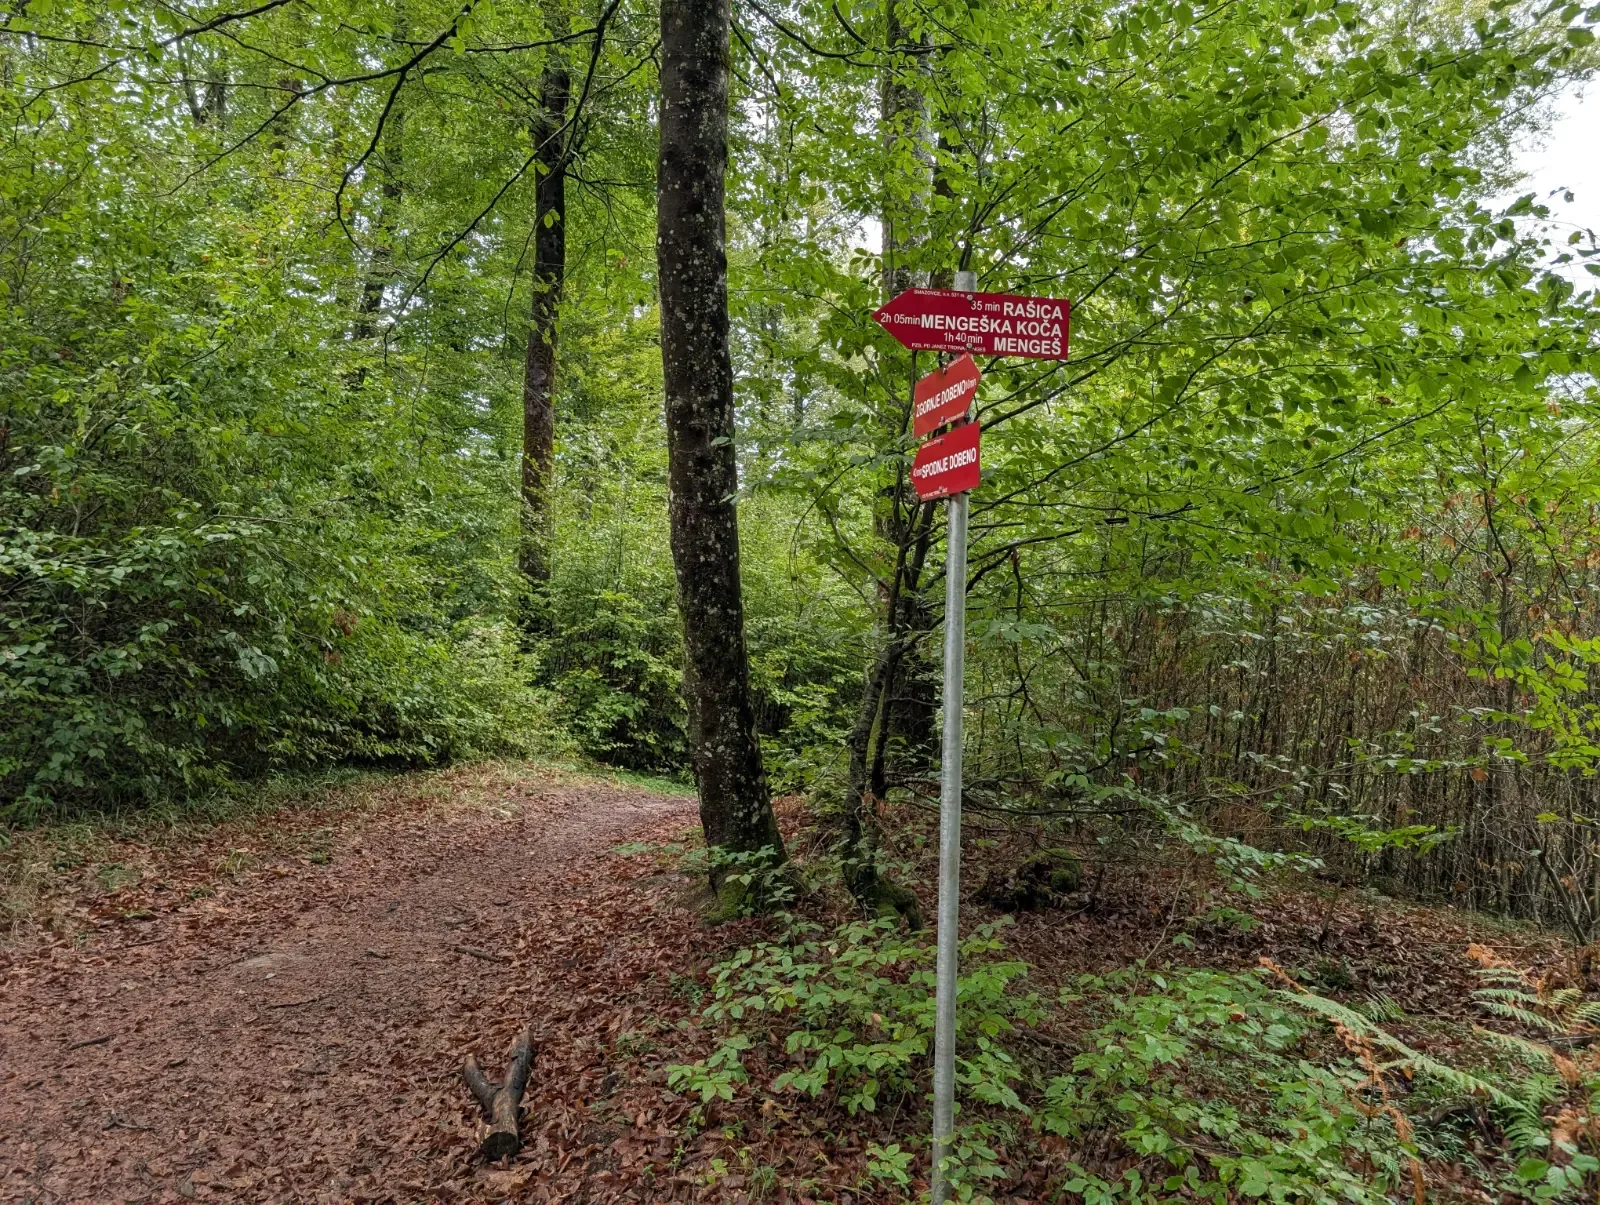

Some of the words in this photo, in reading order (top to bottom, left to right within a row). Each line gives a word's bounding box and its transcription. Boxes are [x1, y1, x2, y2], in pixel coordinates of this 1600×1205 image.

[970, 301, 983, 311] 35
[984, 302, 1001, 312] min
[1003, 300, 1063, 320] RAŠICA
[880, 312, 892, 323] 2h
[894, 313, 921, 326] 05min
[921, 314, 1013, 334] MENGEŠKA
[1016, 320, 1063, 338] KOČA
[943, 332, 954, 342] 1h
[955, 333, 967, 343] 40
[967, 334, 983, 344] min
[993, 337, 1062, 356] MENGEŠ
[916, 392, 941, 418] ZGORNJE
[941, 379, 966, 406] DOBENO
[921, 456, 949, 479] SPODNJE
[949, 446, 977, 470] DOBENO
